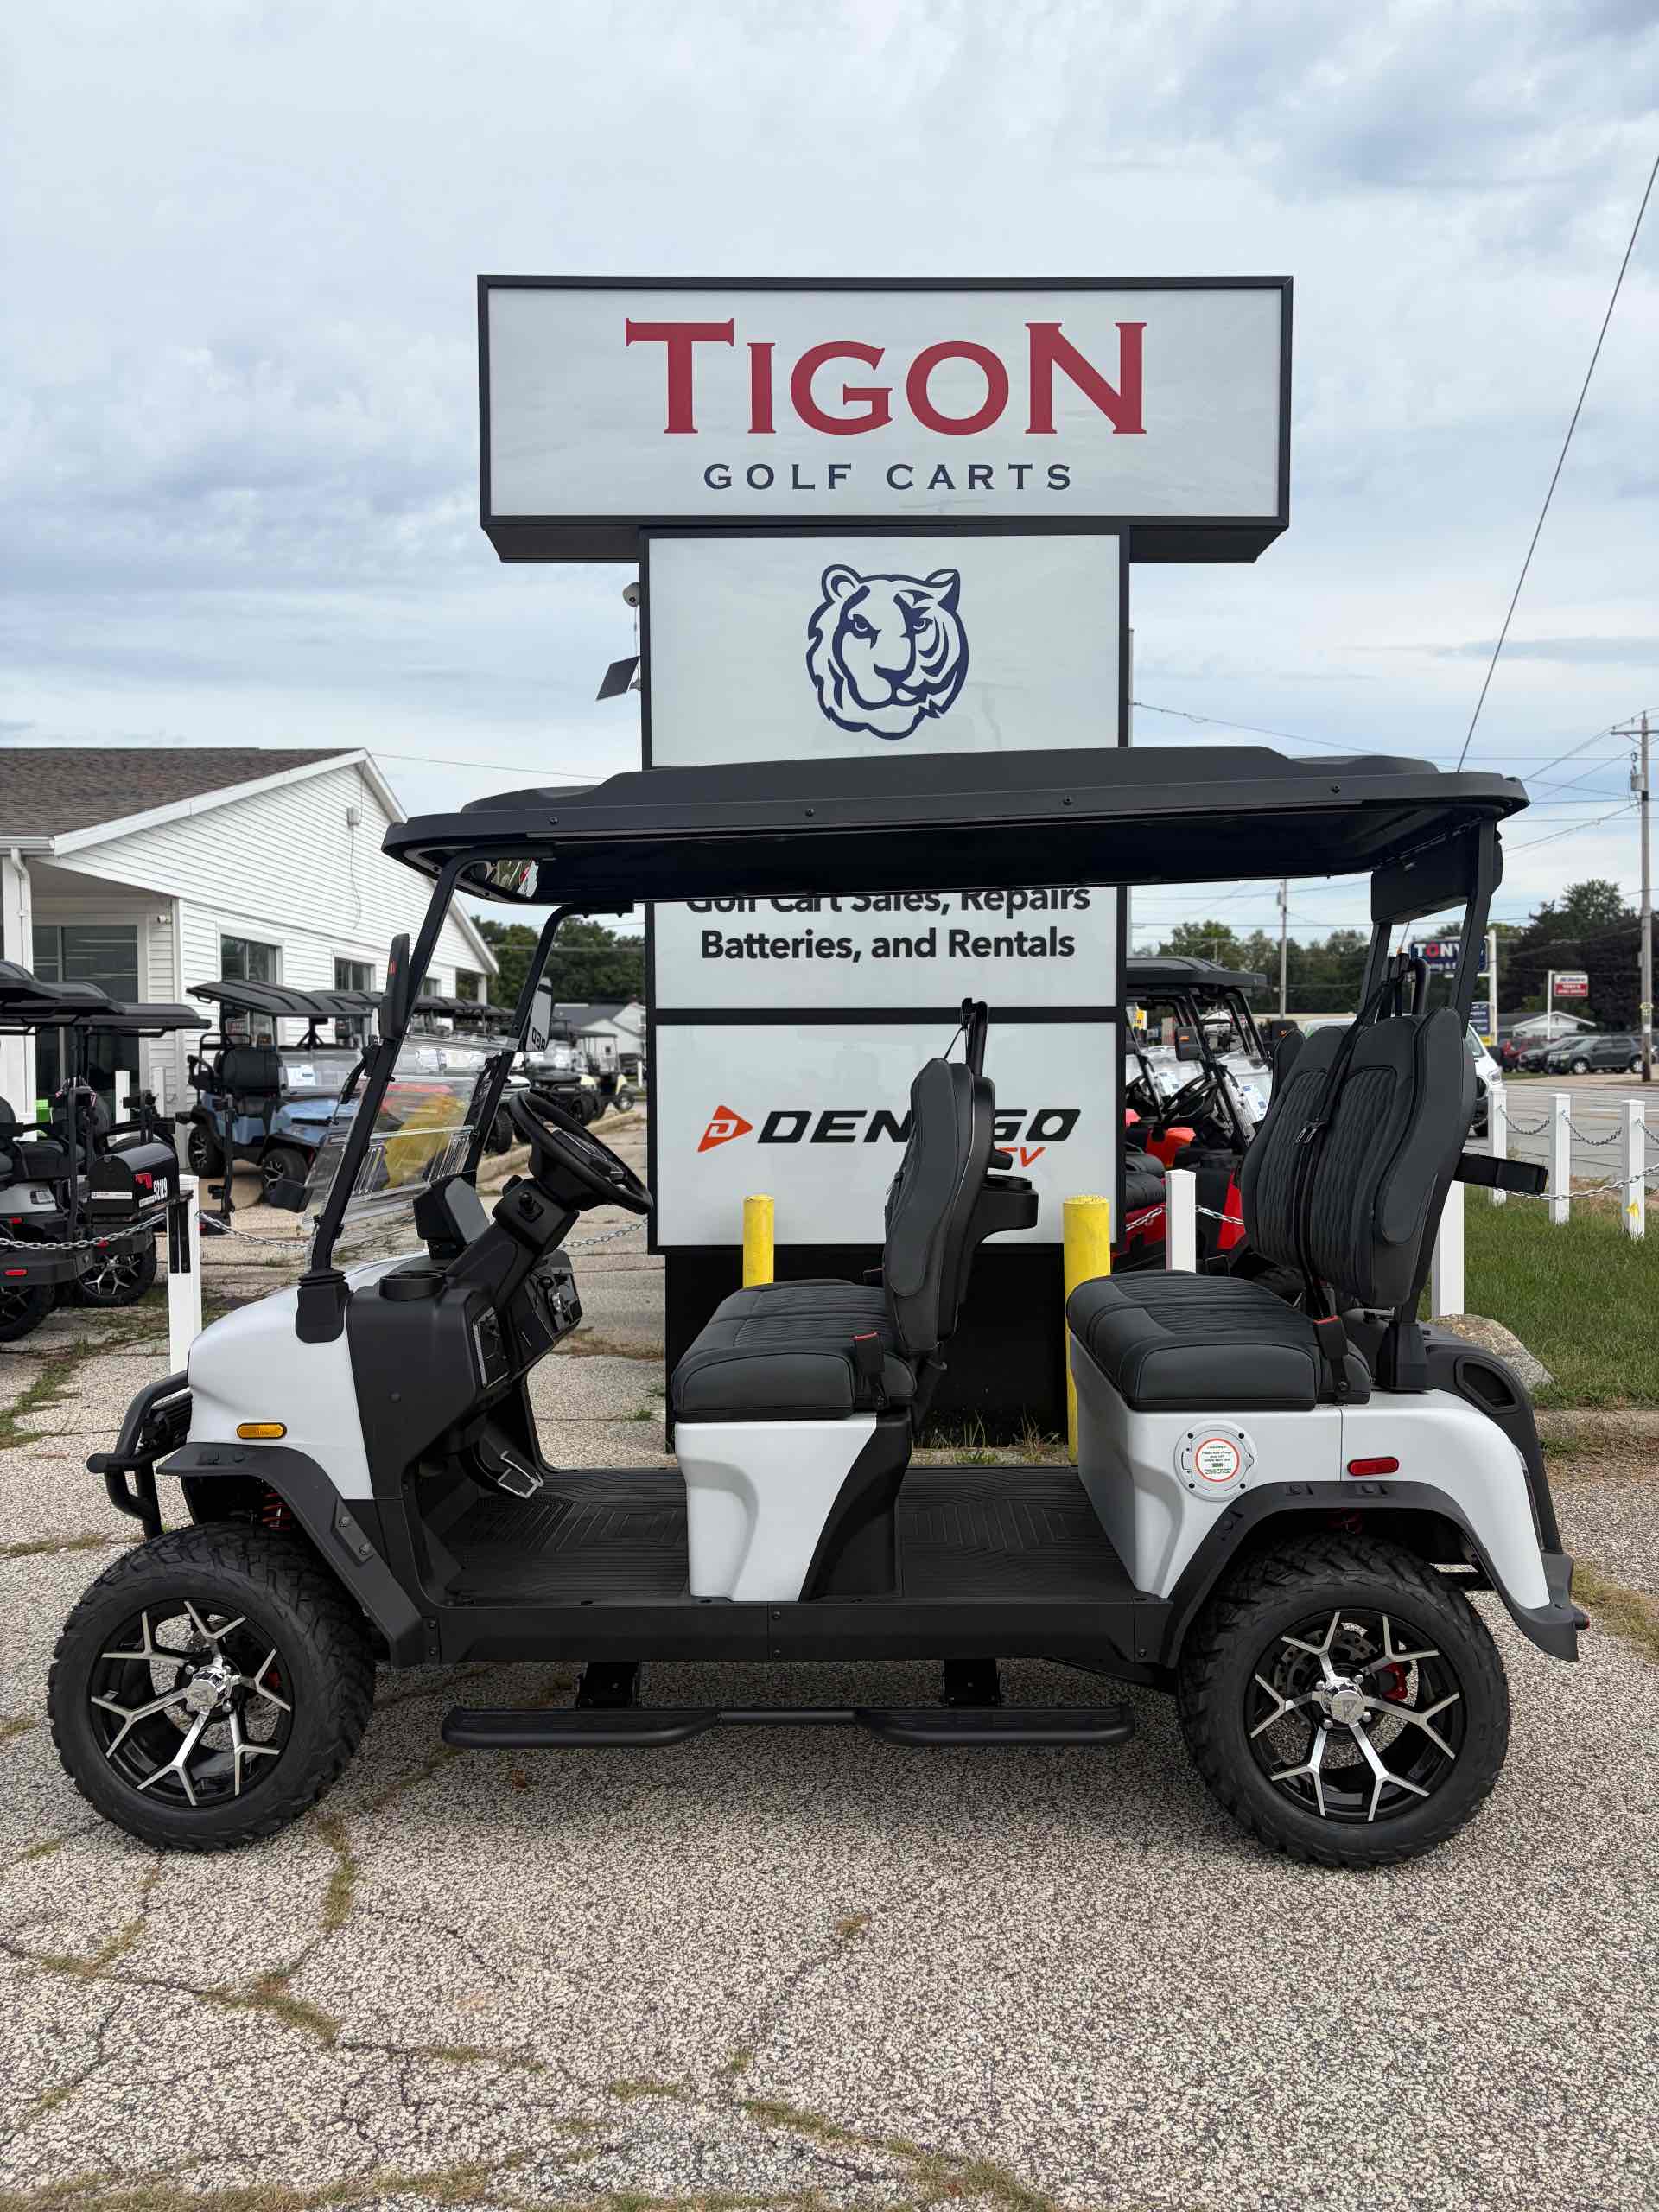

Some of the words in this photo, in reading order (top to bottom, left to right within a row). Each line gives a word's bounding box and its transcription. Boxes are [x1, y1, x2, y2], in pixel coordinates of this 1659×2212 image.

[626, 318, 1146, 435] TIGON
[703, 462, 852, 490] GOLF
[886, 463, 1071, 491] CARTS
[961, 890, 1090, 920] Repairs
[702, 928, 861, 963] Batteries,
[871, 926, 937, 959] and
[949, 925, 1075, 958] Rentals
[757, 1109, 1082, 1143] DENGO
